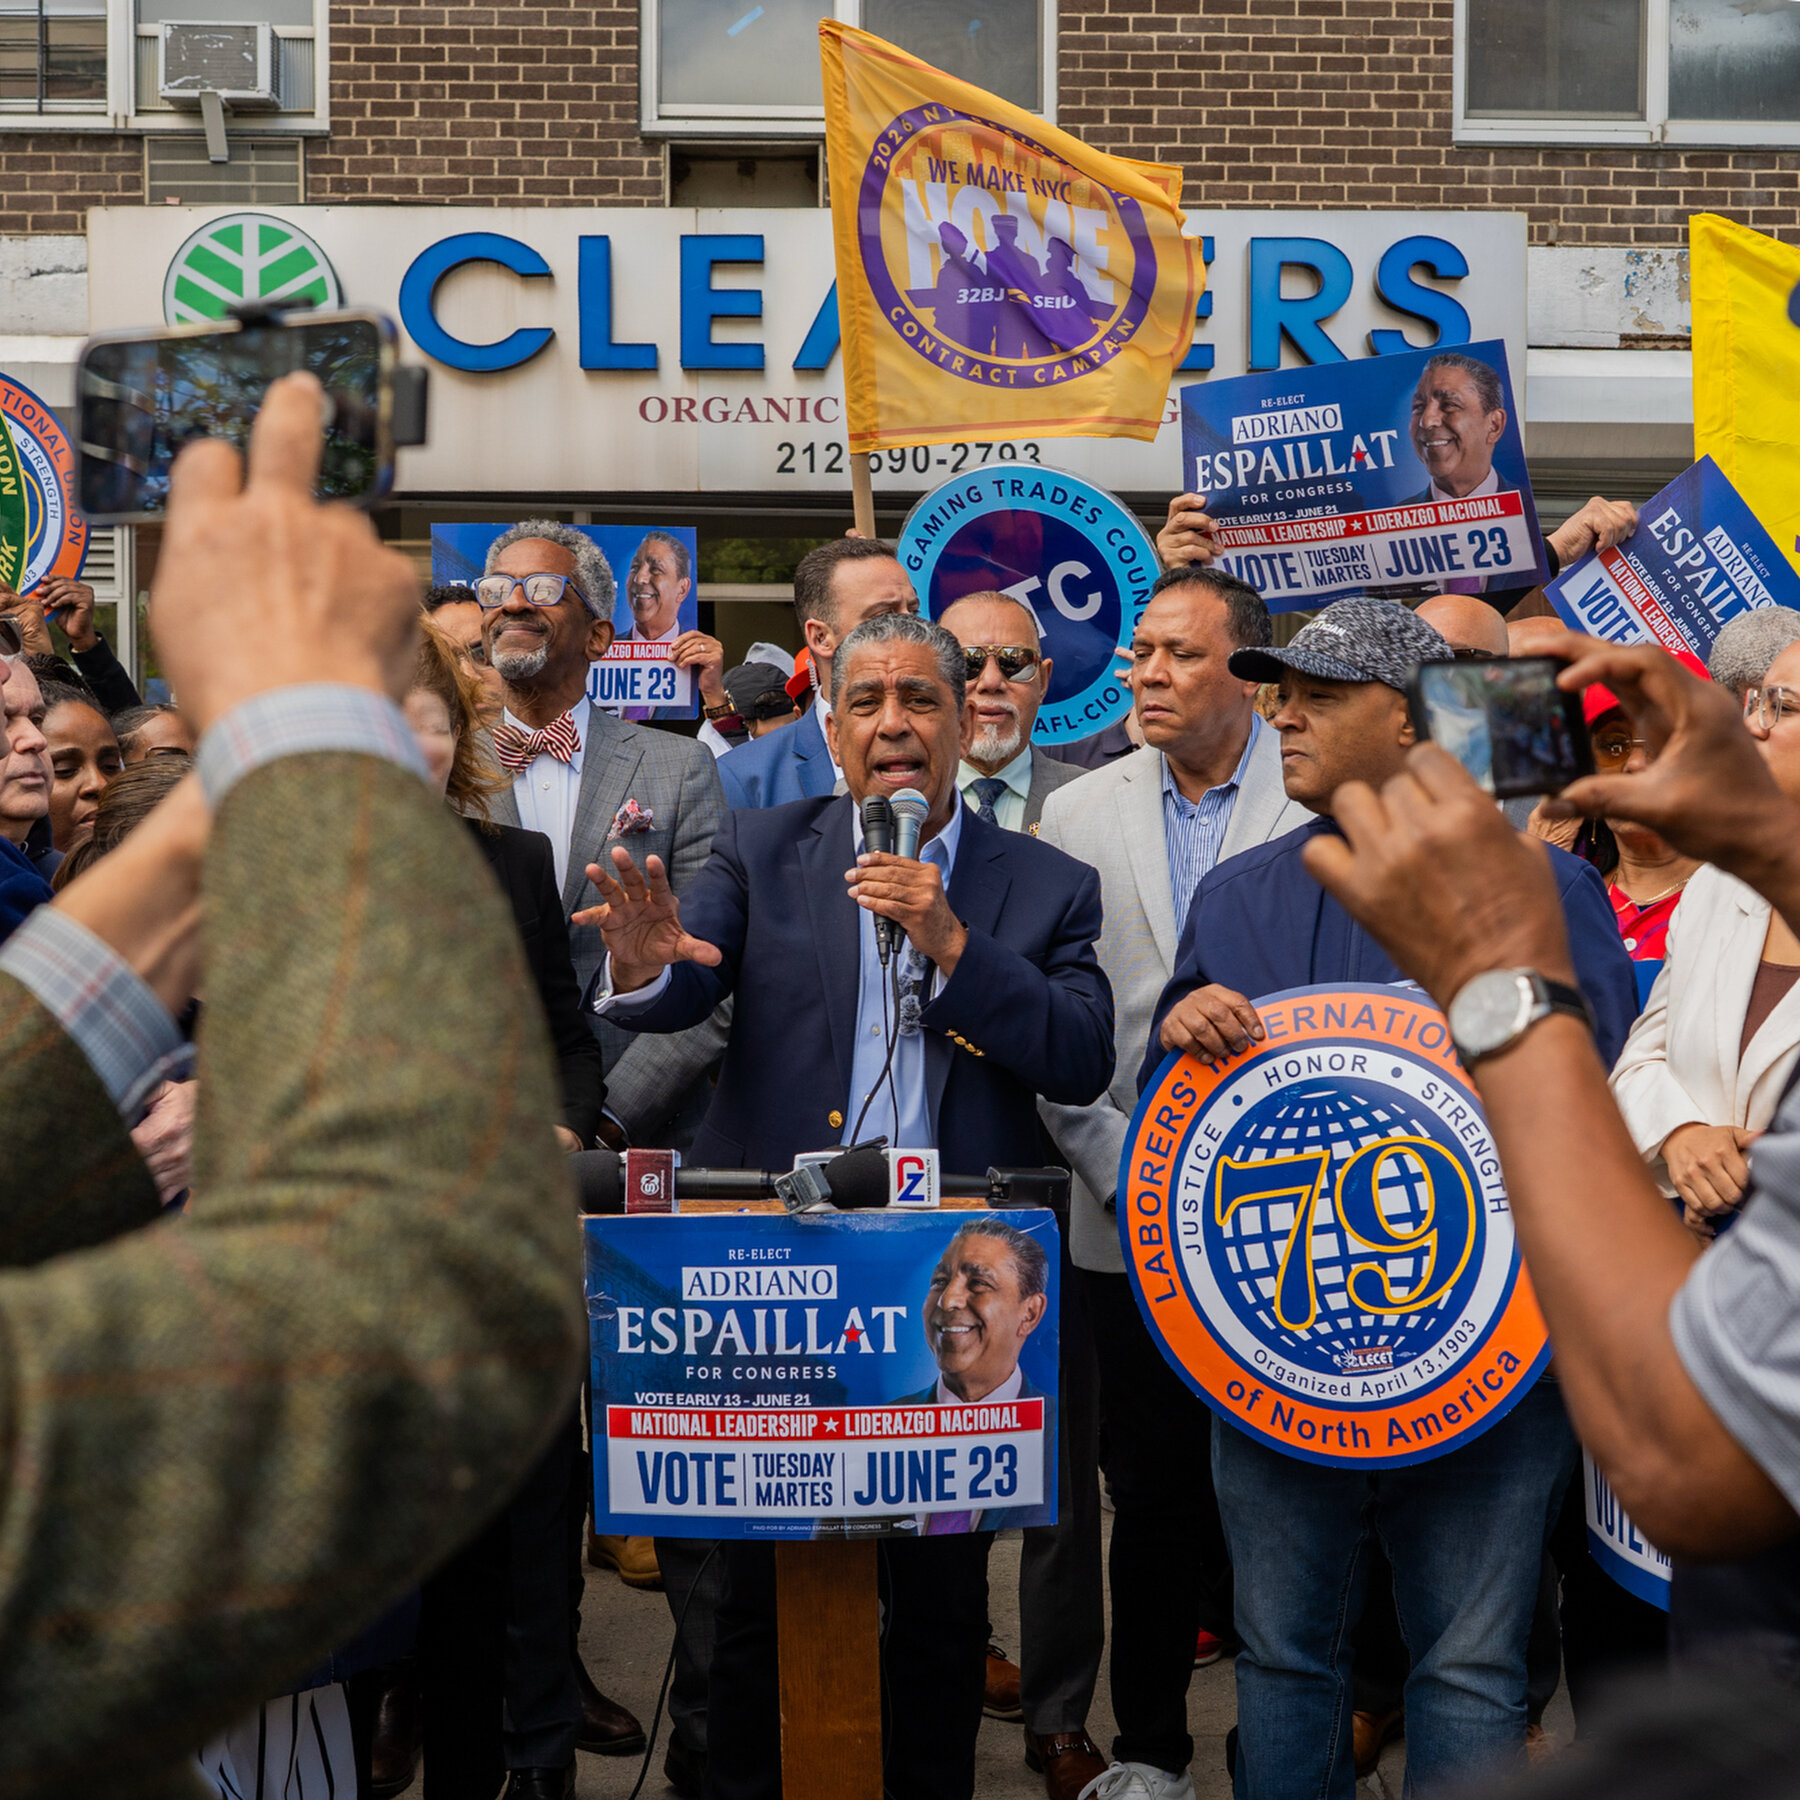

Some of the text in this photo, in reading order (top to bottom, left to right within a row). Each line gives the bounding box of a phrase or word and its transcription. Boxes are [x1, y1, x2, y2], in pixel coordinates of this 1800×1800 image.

[873, 119, 913, 170] 2026
[928, 156, 1072, 205] WE MAKE NYC
[899, 177, 1114, 304] HOME
[400, 232, 1471, 372] CLERS
[956, 288, 1005, 304] 32BJ
[890, 306, 1017, 384] CONTRACT
[3, 387, 67, 463] TIONAL
[638, 394, 840, 425] ORGANIC
[1236, 405, 1339, 441] ADRIANO
[1261, 394, 1305, 408] RE-ELECT
[20, 437, 59, 520] STRENGTH
[776, 441, 1041, 474] 212690-2793
[1195, 429, 1398, 493] ESPAILLAT
[1240, 512, 1272, 524] EARLY
[1274, 511, 1287, 521] 13
[1295, 506, 1324, 519] JUNE
[1325, 504, 1339, 516] 21
[1241, 481, 1353, 506] FOR CONGRESS
[1271, 518, 1347, 543] LEADERSHIP
[1367, 506, 1436, 533] LIDERAZGO
[1438, 497, 1505, 521] NACIONAL
[907, 478, 1151, 629] GAMING TRADES COUN
[1222, 526, 1513, 593] VOTE TUESDAY JUNE 23
[1312, 563, 1372, 588] MARTES
[1647, 506, 1747, 628] ESPAIL
[1706, 531, 1772, 608] ADRIANO
[1741, 542, 1771, 579] RE-ELECT
[998, 560, 1102, 640] TC
[1608, 557, 1651, 611] NATIONAL
[1627, 551, 1648, 578] VOTE
[1642, 573, 1667, 602] EARLY
[1661, 599, 1674, 613] 13
[1672, 614, 1695, 641] JUNE
[1688, 637, 1701, 651] 21
[1661, 568, 1717, 643] FOR CONGRE
[633, 644, 673, 659] NACIONA
[587, 667, 676, 700] JUNE 23
[1034, 686, 1120, 733] AFL-CIO
[1136, 1002, 1462, 1302] LABORERS' ERNATIO
[1181, 1053, 1510, 1255] JUSTICE HONOR STRENGTH
[728, 1247, 791, 1260] RE-ELECT
[1215, 1136, 1476, 1331] 79
[686, 1269, 834, 1297] ADRIANO
[616, 1305, 907, 1356] ESPAILLAT
[685, 1366, 837, 1380] FOR CONGRESS
[1254, 1348, 1352, 1397] Organized
[1360, 1372, 1408, 1398] April
[1359, 1351, 1394, 1367] LECET
[631, 1405, 1022, 1438] NATIONAL LEADERSHIP LIDERAZGO NACIONAL
[635, 1392, 674, 1405] VOTE
[675, 1392, 723, 1406] EARLY
[724, 1392, 741, 1406] 13
[752, 1392, 793, 1406] JUNE
[794, 1392, 812, 1406] 21
[1226, 1347, 1521, 1448] of North America
[636, 1443, 1019, 1506] VOTE TUESDAY JUNE 23
[755, 1481, 834, 1507] MARTES
